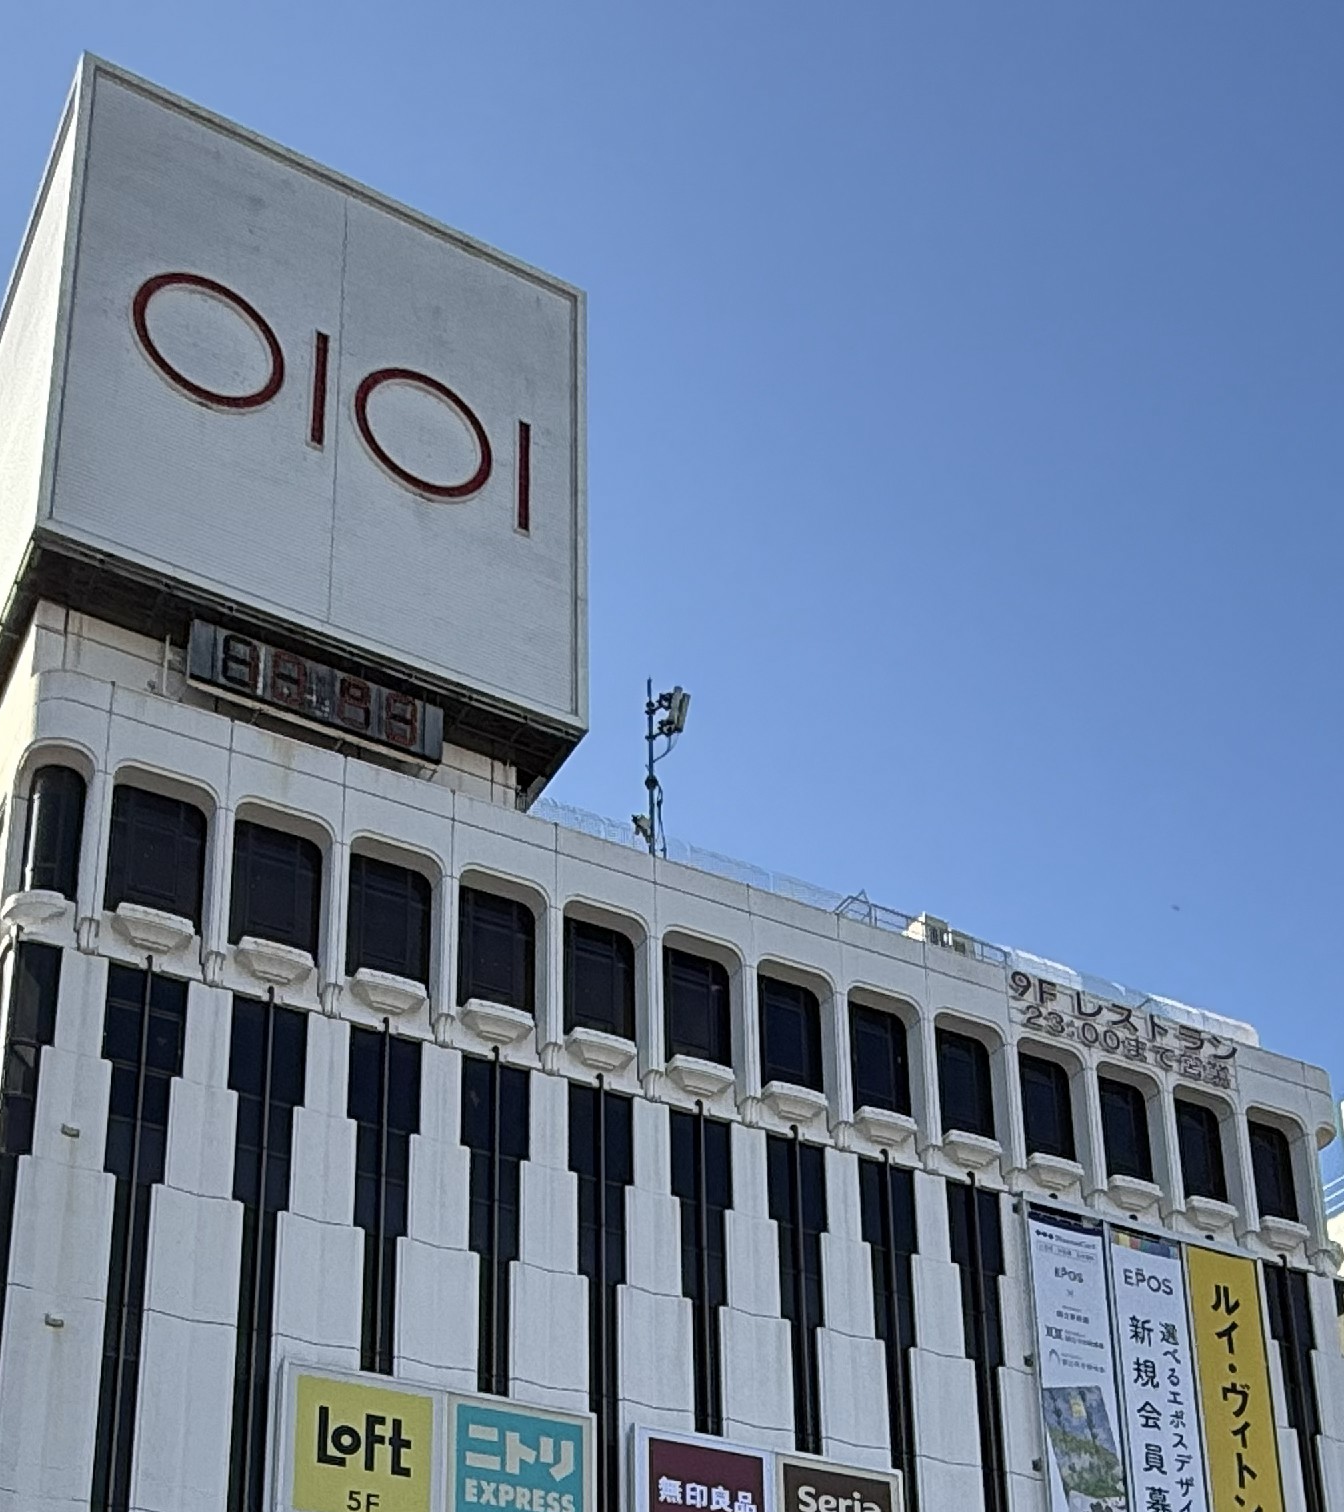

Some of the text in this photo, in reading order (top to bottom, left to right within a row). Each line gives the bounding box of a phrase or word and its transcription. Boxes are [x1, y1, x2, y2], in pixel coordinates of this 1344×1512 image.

[1122, 1267, 1174, 1296] EPOS
[465, 1423, 574, 1483] ニトリ
[347, 1490, 380, 1512] 5F
